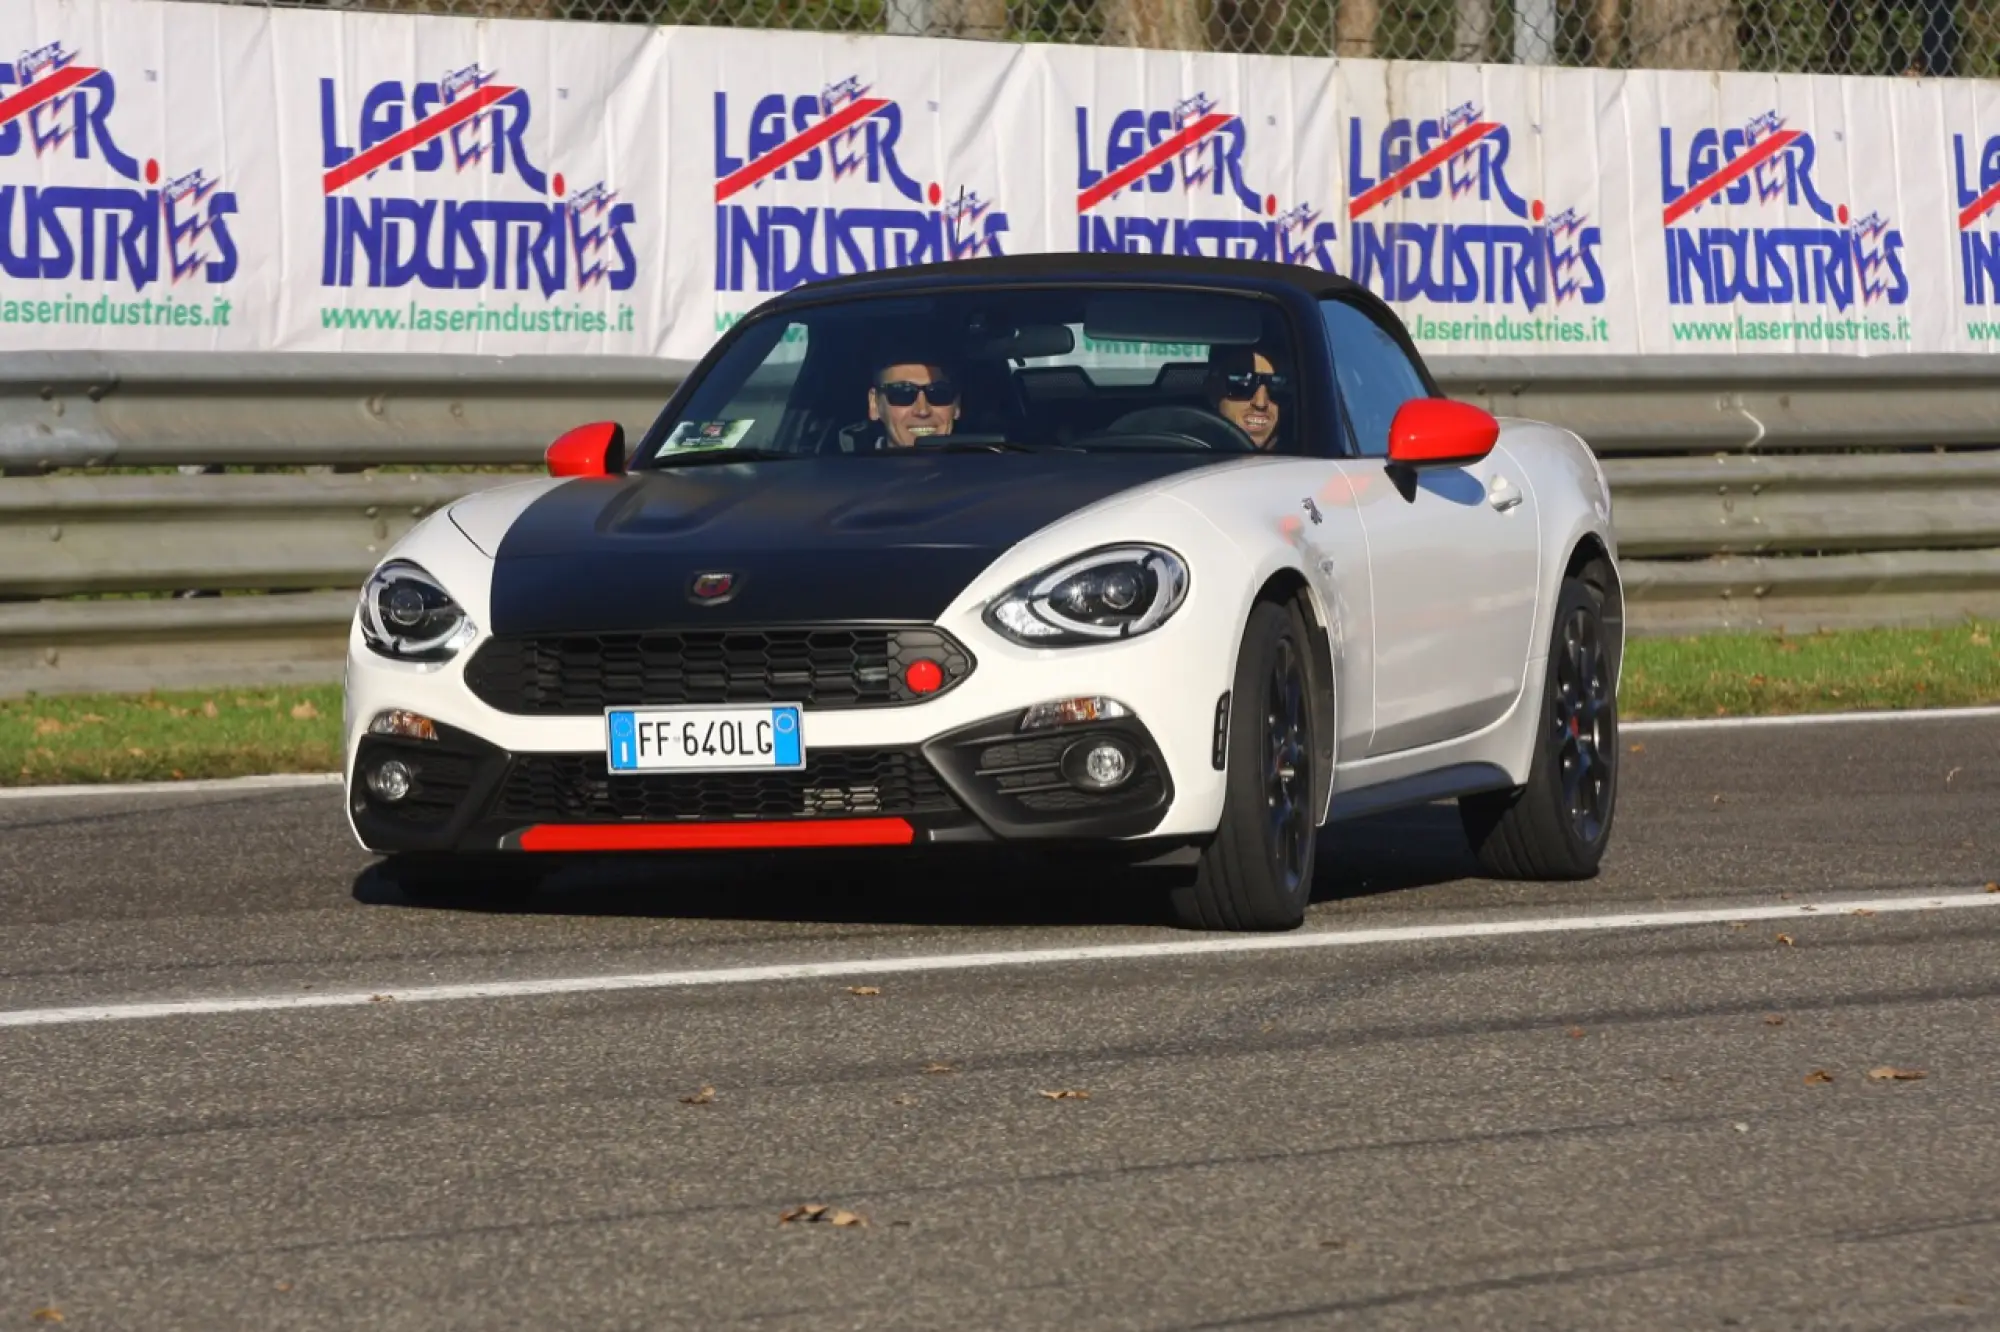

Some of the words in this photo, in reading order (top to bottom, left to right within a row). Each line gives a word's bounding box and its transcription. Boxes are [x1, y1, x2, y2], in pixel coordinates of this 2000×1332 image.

[319, 63, 548, 196] LASER
[714, 75, 924, 204] LASER
[1075, 92, 1262, 215] LASER
[1348, 101, 1528, 219] LASER
[1659, 109, 1836, 227] LASER
[321, 180, 637, 300] INDUSTRIES
[1664, 209, 1909, 314] INDUSTRIES
[320, 302, 635, 332] www.laserindustries.it
[1672, 315, 1912, 341] www.laserindustries.it
[638, 722, 671, 757] FF
